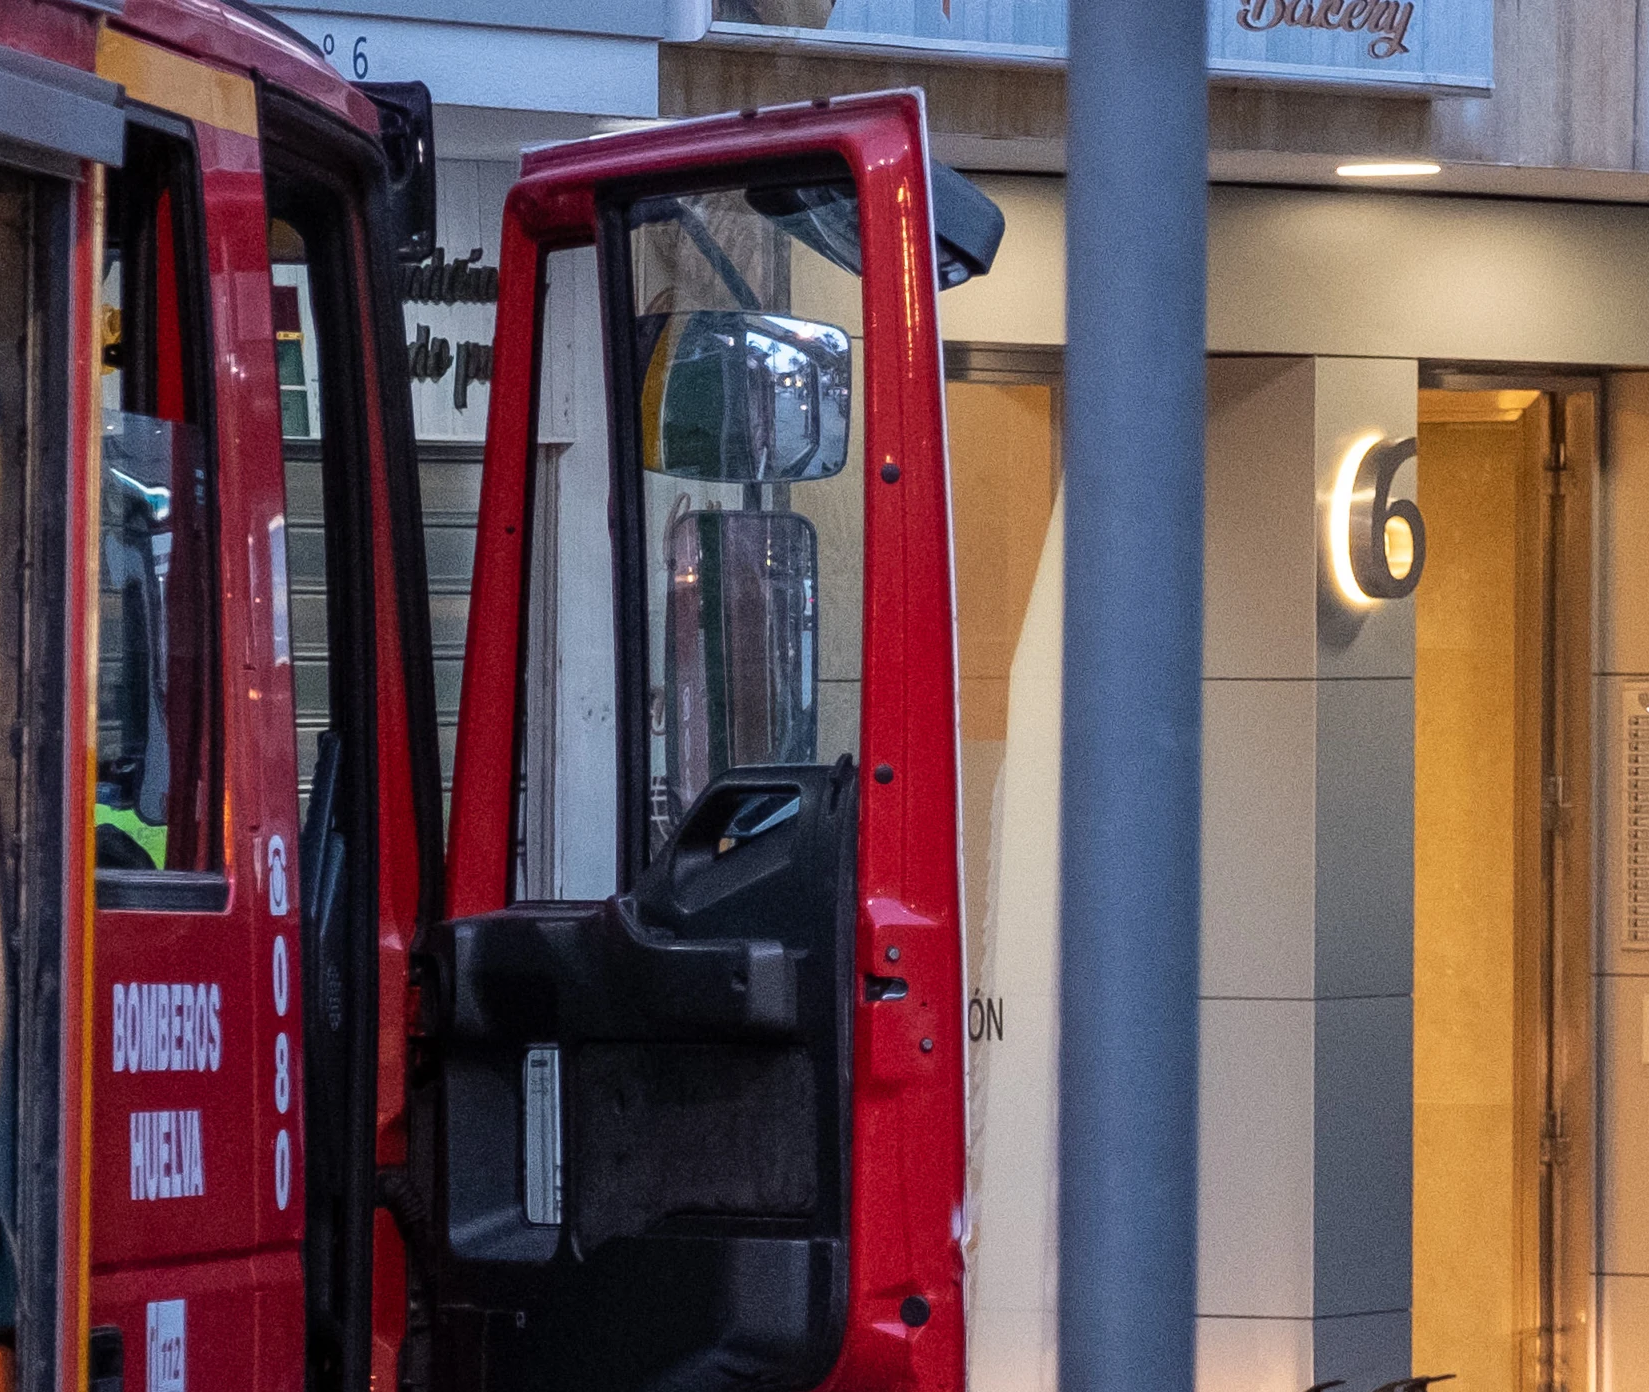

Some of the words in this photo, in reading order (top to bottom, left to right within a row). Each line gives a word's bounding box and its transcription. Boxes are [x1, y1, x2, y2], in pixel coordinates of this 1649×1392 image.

[1341, 434, 1426, 600] 6
[113, 982, 221, 1074] BOMBEROS
[130, 1110, 204, 1201] HUELVA
